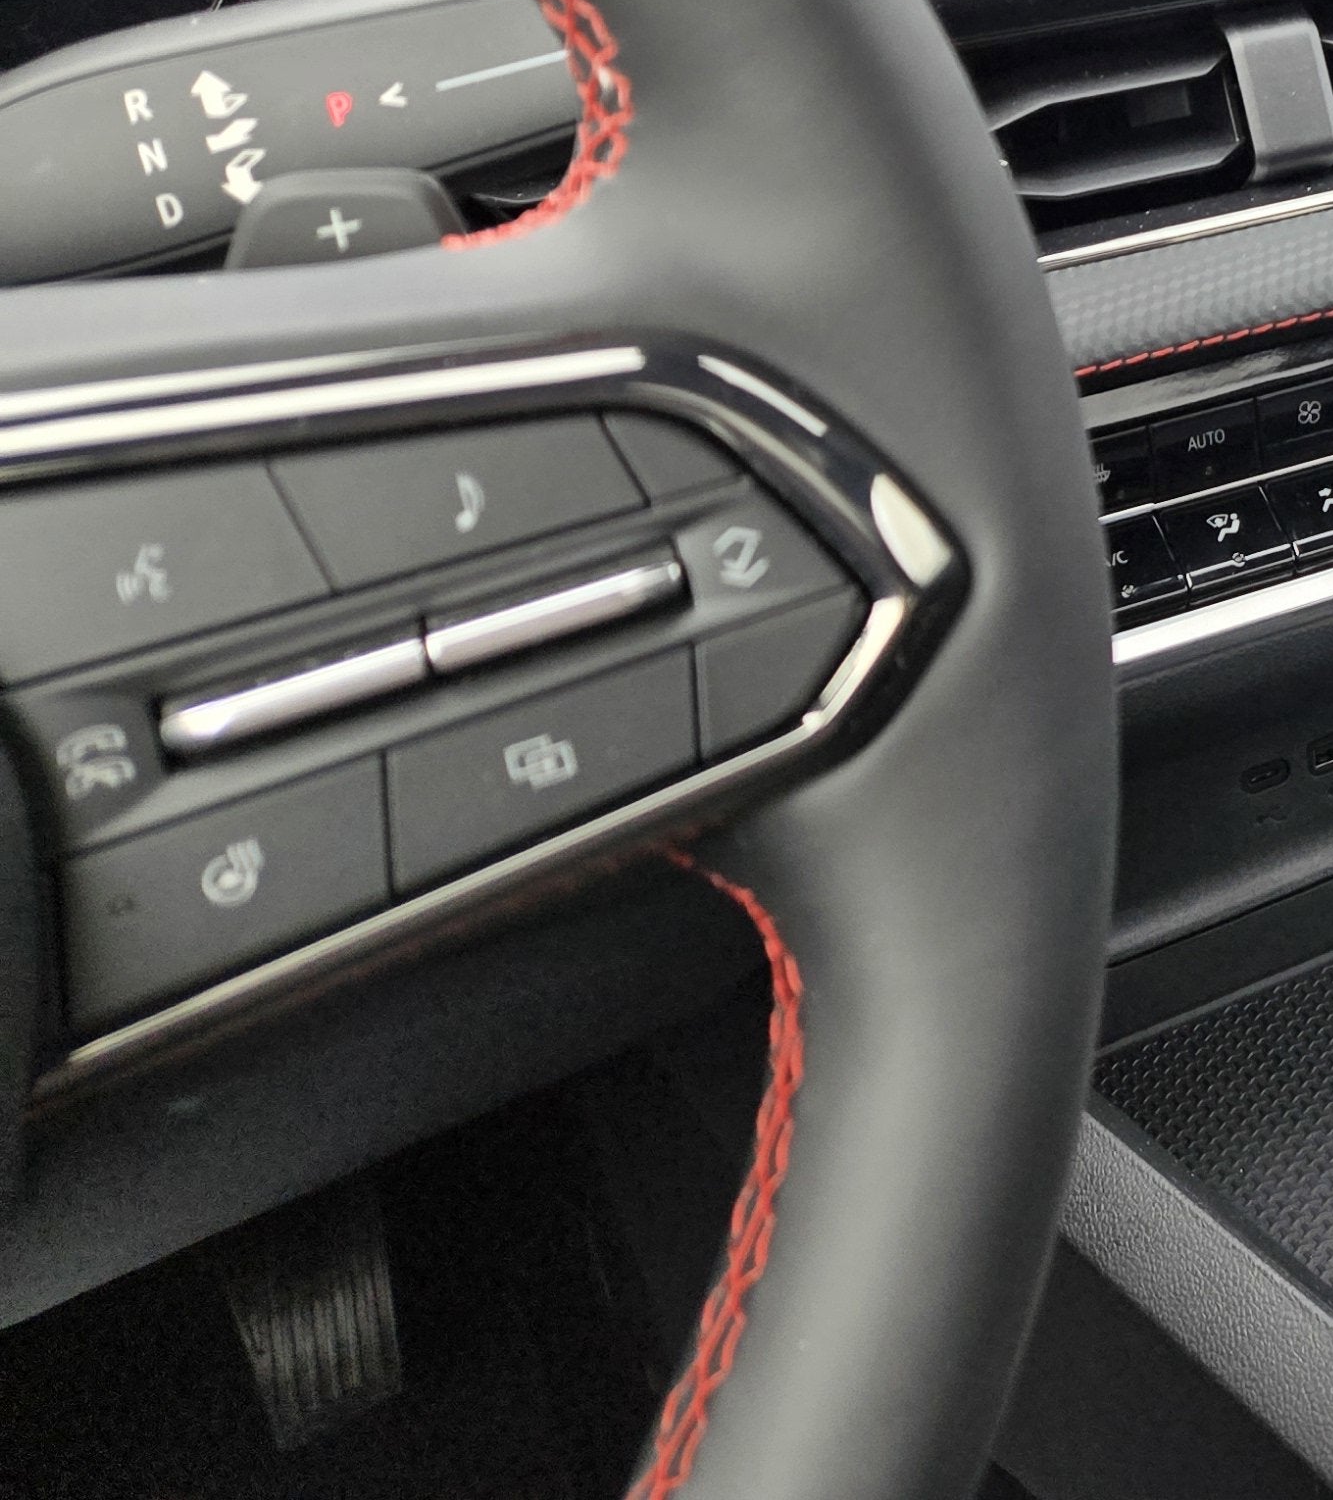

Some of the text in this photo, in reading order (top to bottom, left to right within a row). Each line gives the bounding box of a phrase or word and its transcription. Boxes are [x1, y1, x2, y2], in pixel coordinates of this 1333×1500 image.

[124, 88, 152, 124] R
[325, 90, 353, 128] P
[138, 139, 168, 175] N
[155, 192, 184, 229] D
[1188, 429, 1226, 452] AUTO
[1105, 550, 1129, 567] /C
